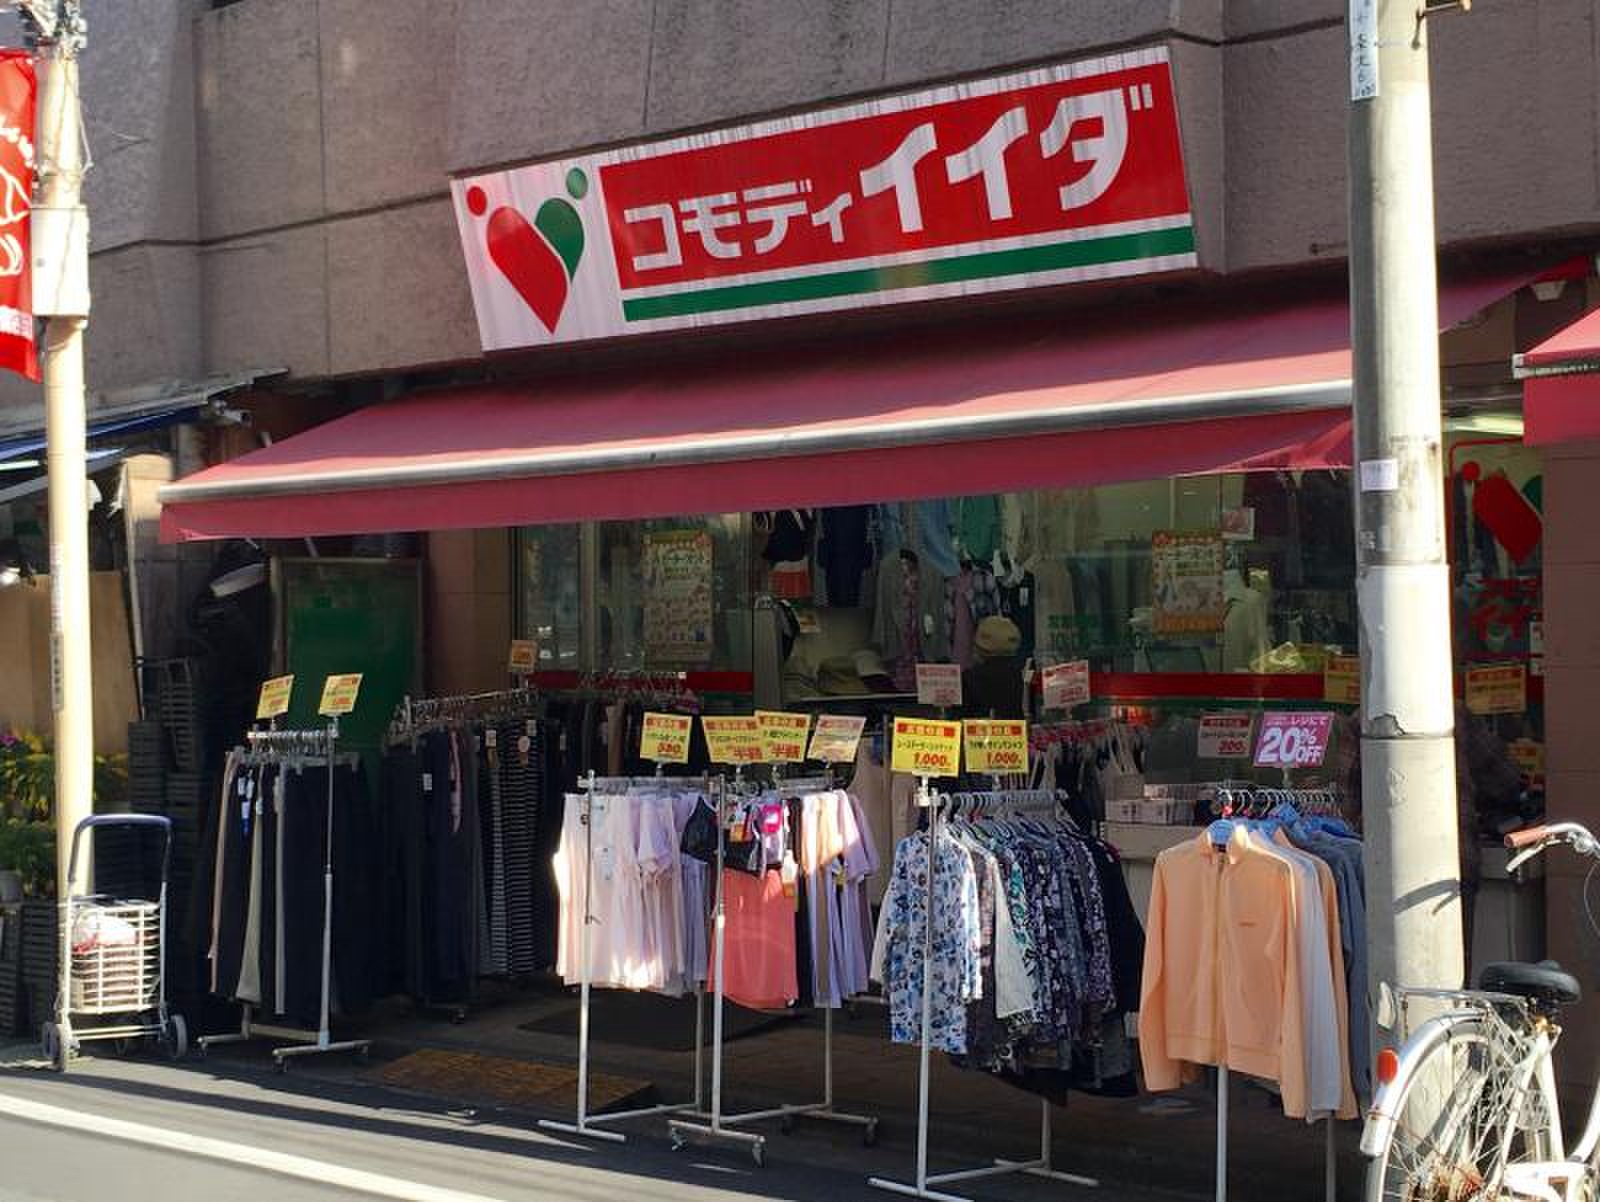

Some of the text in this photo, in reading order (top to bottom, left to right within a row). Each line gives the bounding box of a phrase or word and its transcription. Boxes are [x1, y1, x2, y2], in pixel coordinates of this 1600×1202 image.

[623, 83, 1153, 272] コモディイイダ
[1258, 727, 1317, 763] 20%
[1296, 746, 1321, 764] OFF
